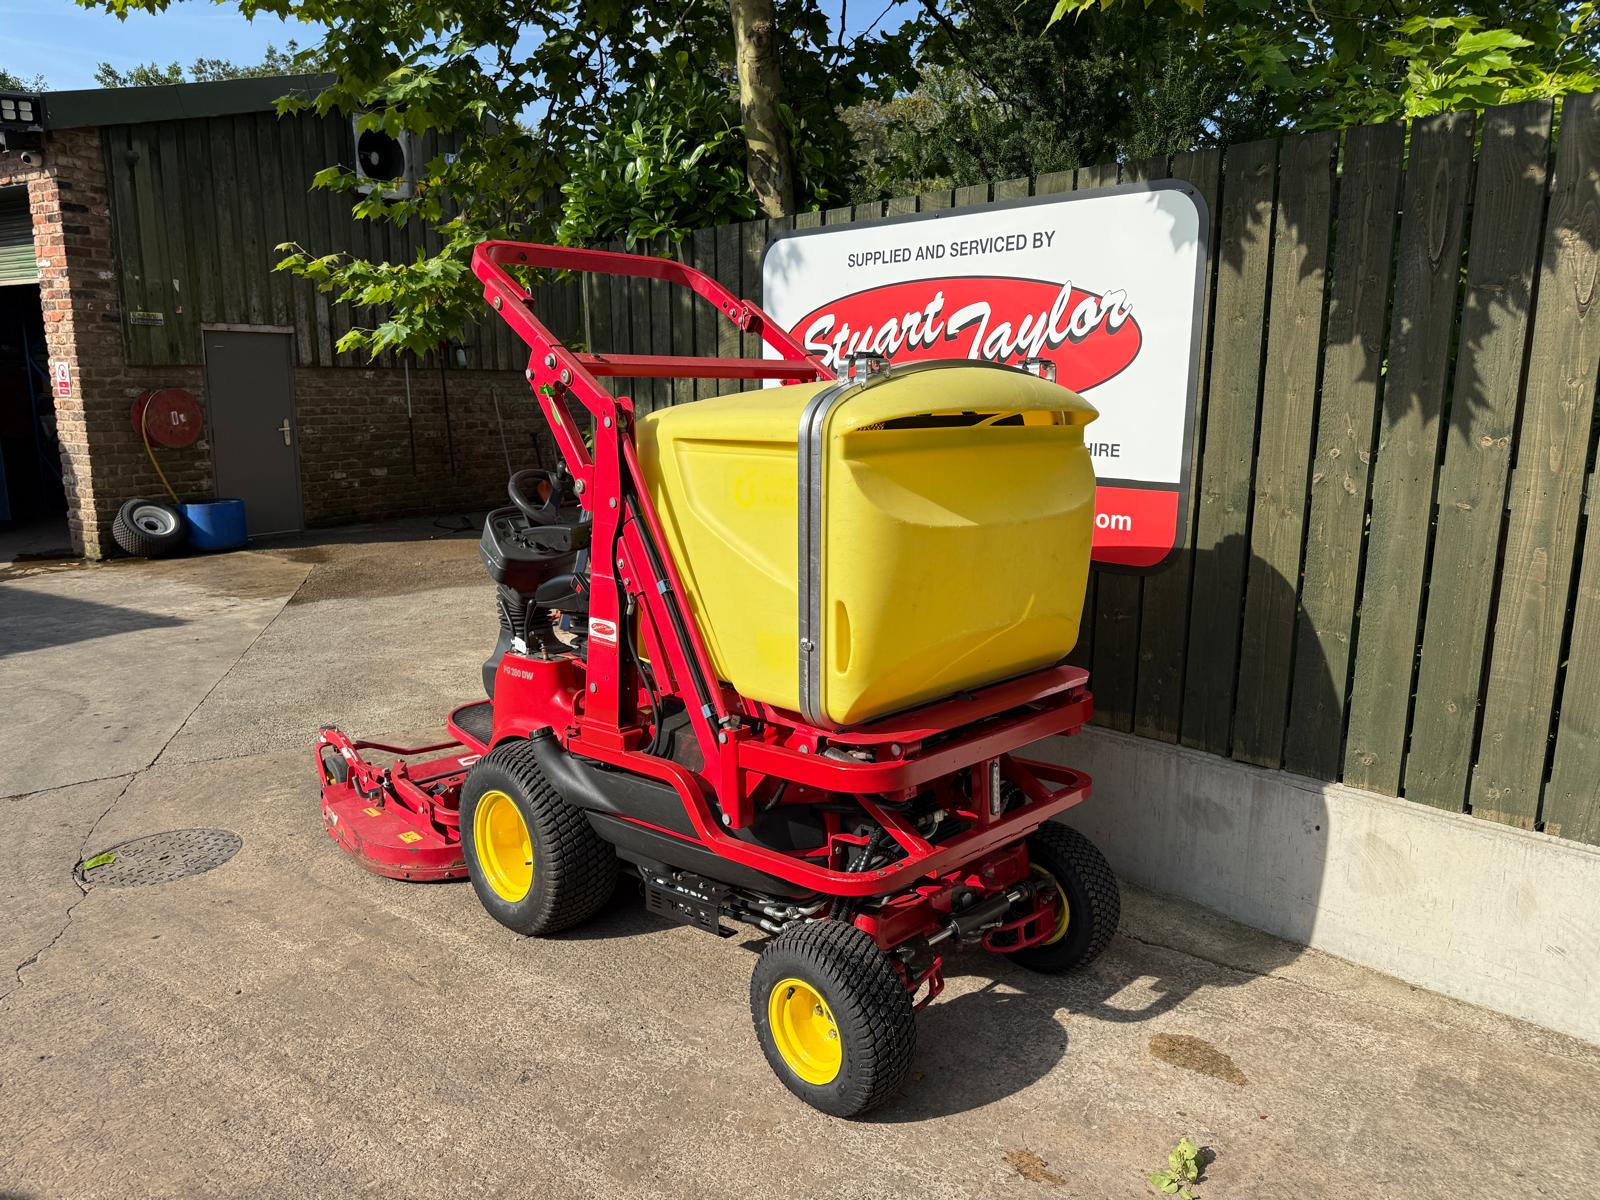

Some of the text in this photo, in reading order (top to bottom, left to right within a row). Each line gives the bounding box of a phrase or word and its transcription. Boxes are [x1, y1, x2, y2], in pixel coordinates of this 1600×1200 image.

[848, 230, 1056, 268] SUPPLIED AND SERVICED BY
[804, 280, 1133, 369] Stuart Taylor
